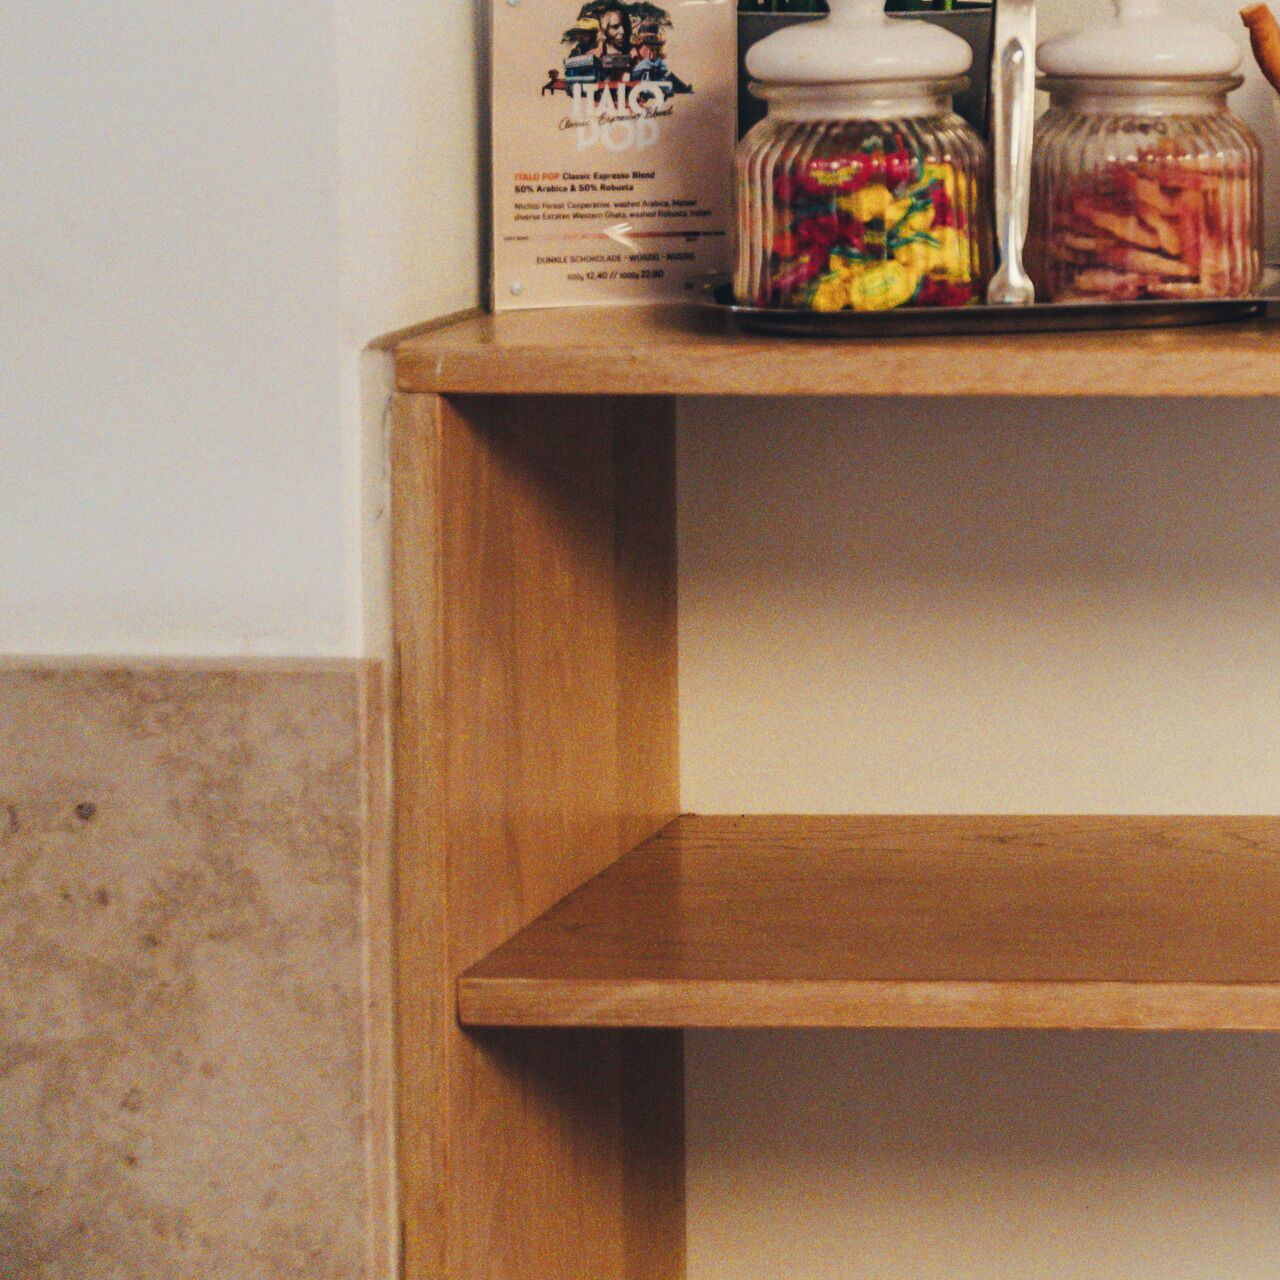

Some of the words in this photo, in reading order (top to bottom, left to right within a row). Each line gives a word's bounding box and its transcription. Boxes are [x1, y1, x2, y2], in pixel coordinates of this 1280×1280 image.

[572, 80, 666, 118] ITALO
[576, 117, 660, 152] POP
[562, 171, 591, 180] Classic
[593, 171, 630, 182] Espresso
[632, 170, 656, 180] Blend
[514, 184, 534, 193] 50%
[536, 183, 568, 192] Arabica
[579, 182, 598, 192] 50%
[600, 182, 634, 192] Robusta
[536, 255, 568, 264] DUNKLE
[570, 253, 622, 264] SCHOKOLADE
